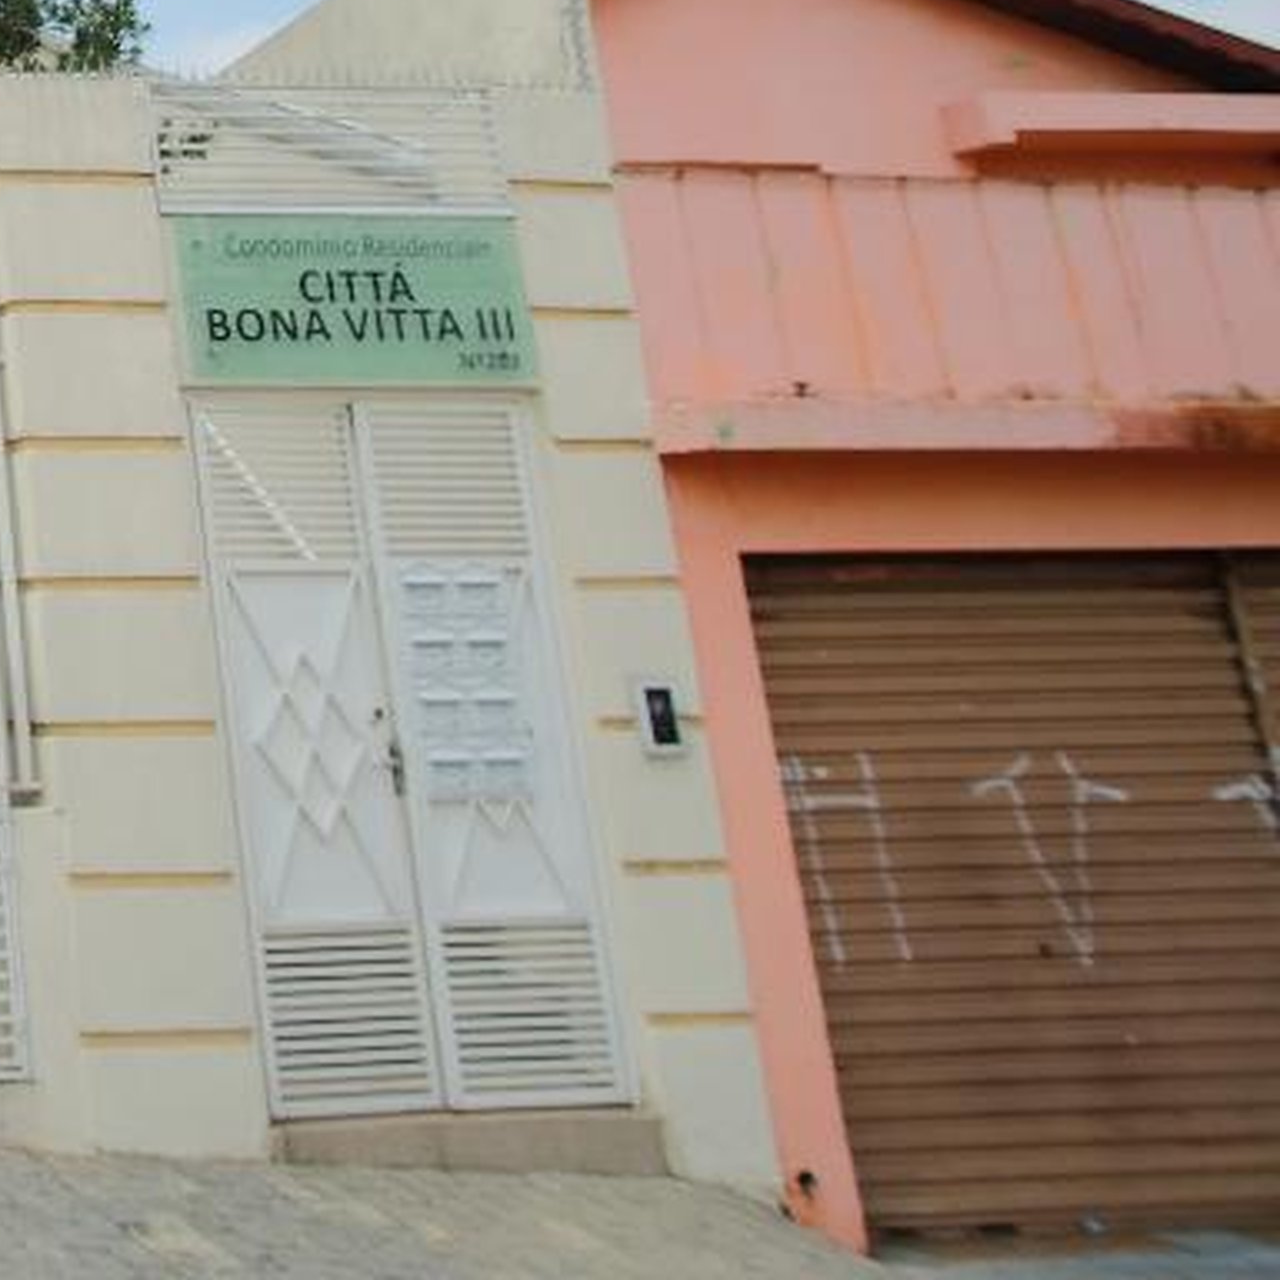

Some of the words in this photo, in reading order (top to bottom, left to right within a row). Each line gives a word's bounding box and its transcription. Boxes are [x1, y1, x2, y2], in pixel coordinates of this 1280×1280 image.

[207, 309, 332, 342] BONA
[342, 308, 463, 342] VITTA
[476, 308, 516, 342] III
